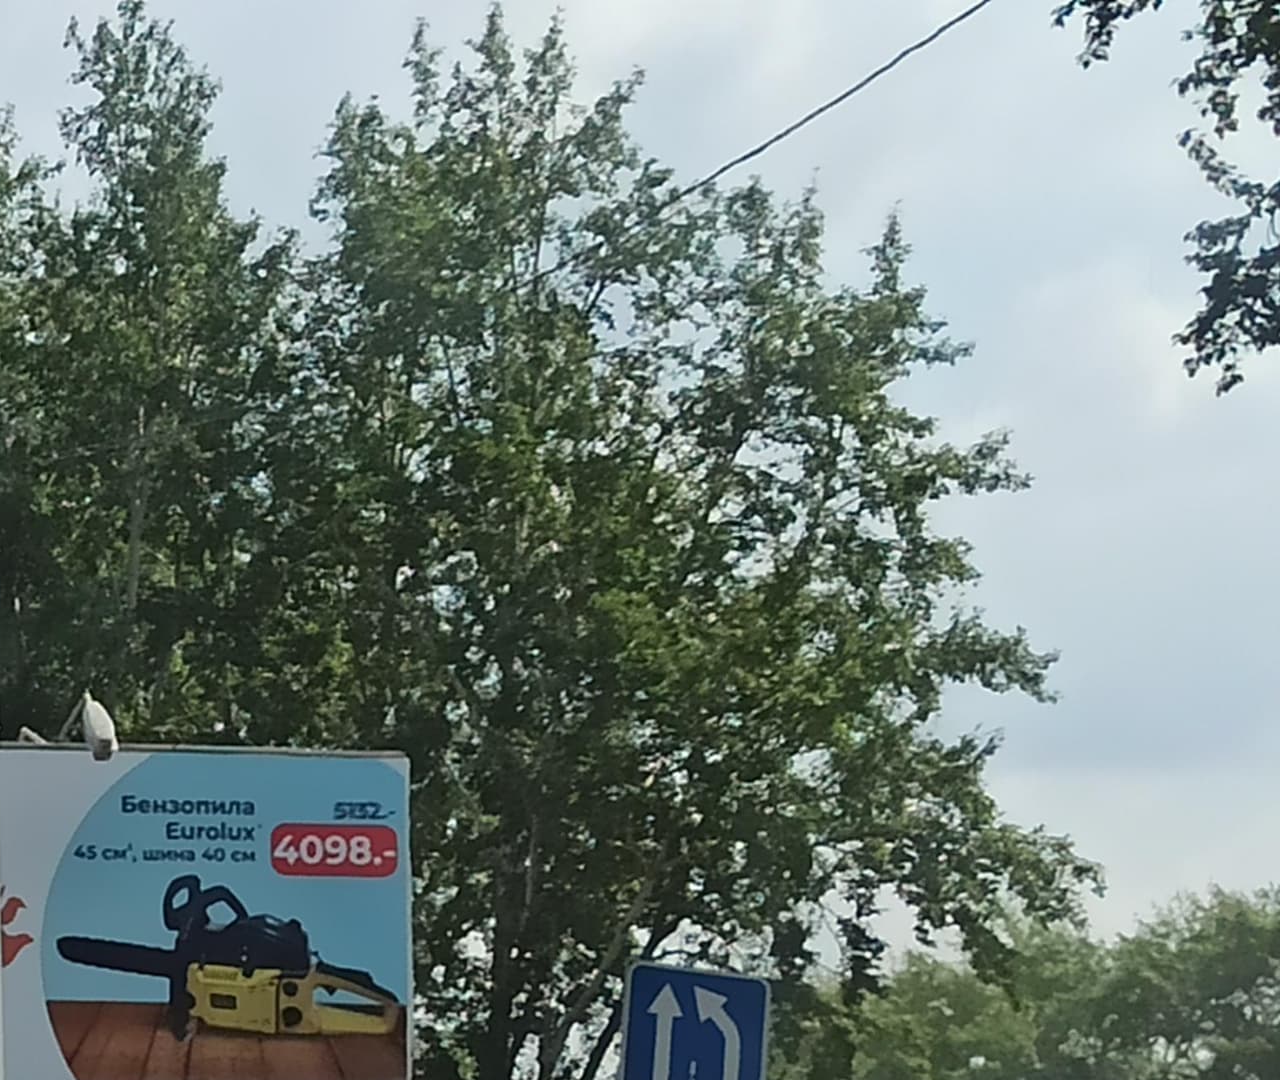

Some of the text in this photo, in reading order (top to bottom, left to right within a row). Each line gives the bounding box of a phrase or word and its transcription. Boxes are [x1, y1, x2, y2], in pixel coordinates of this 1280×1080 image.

[121, 795, 255, 816] Бензопила
[73, 844, 98, 861] 45
[142, 848, 196, 862] шина
[201, 847, 226, 862] 40
[230, 850, 256, 862] см
[273, 834, 396, 866] 4098.-
